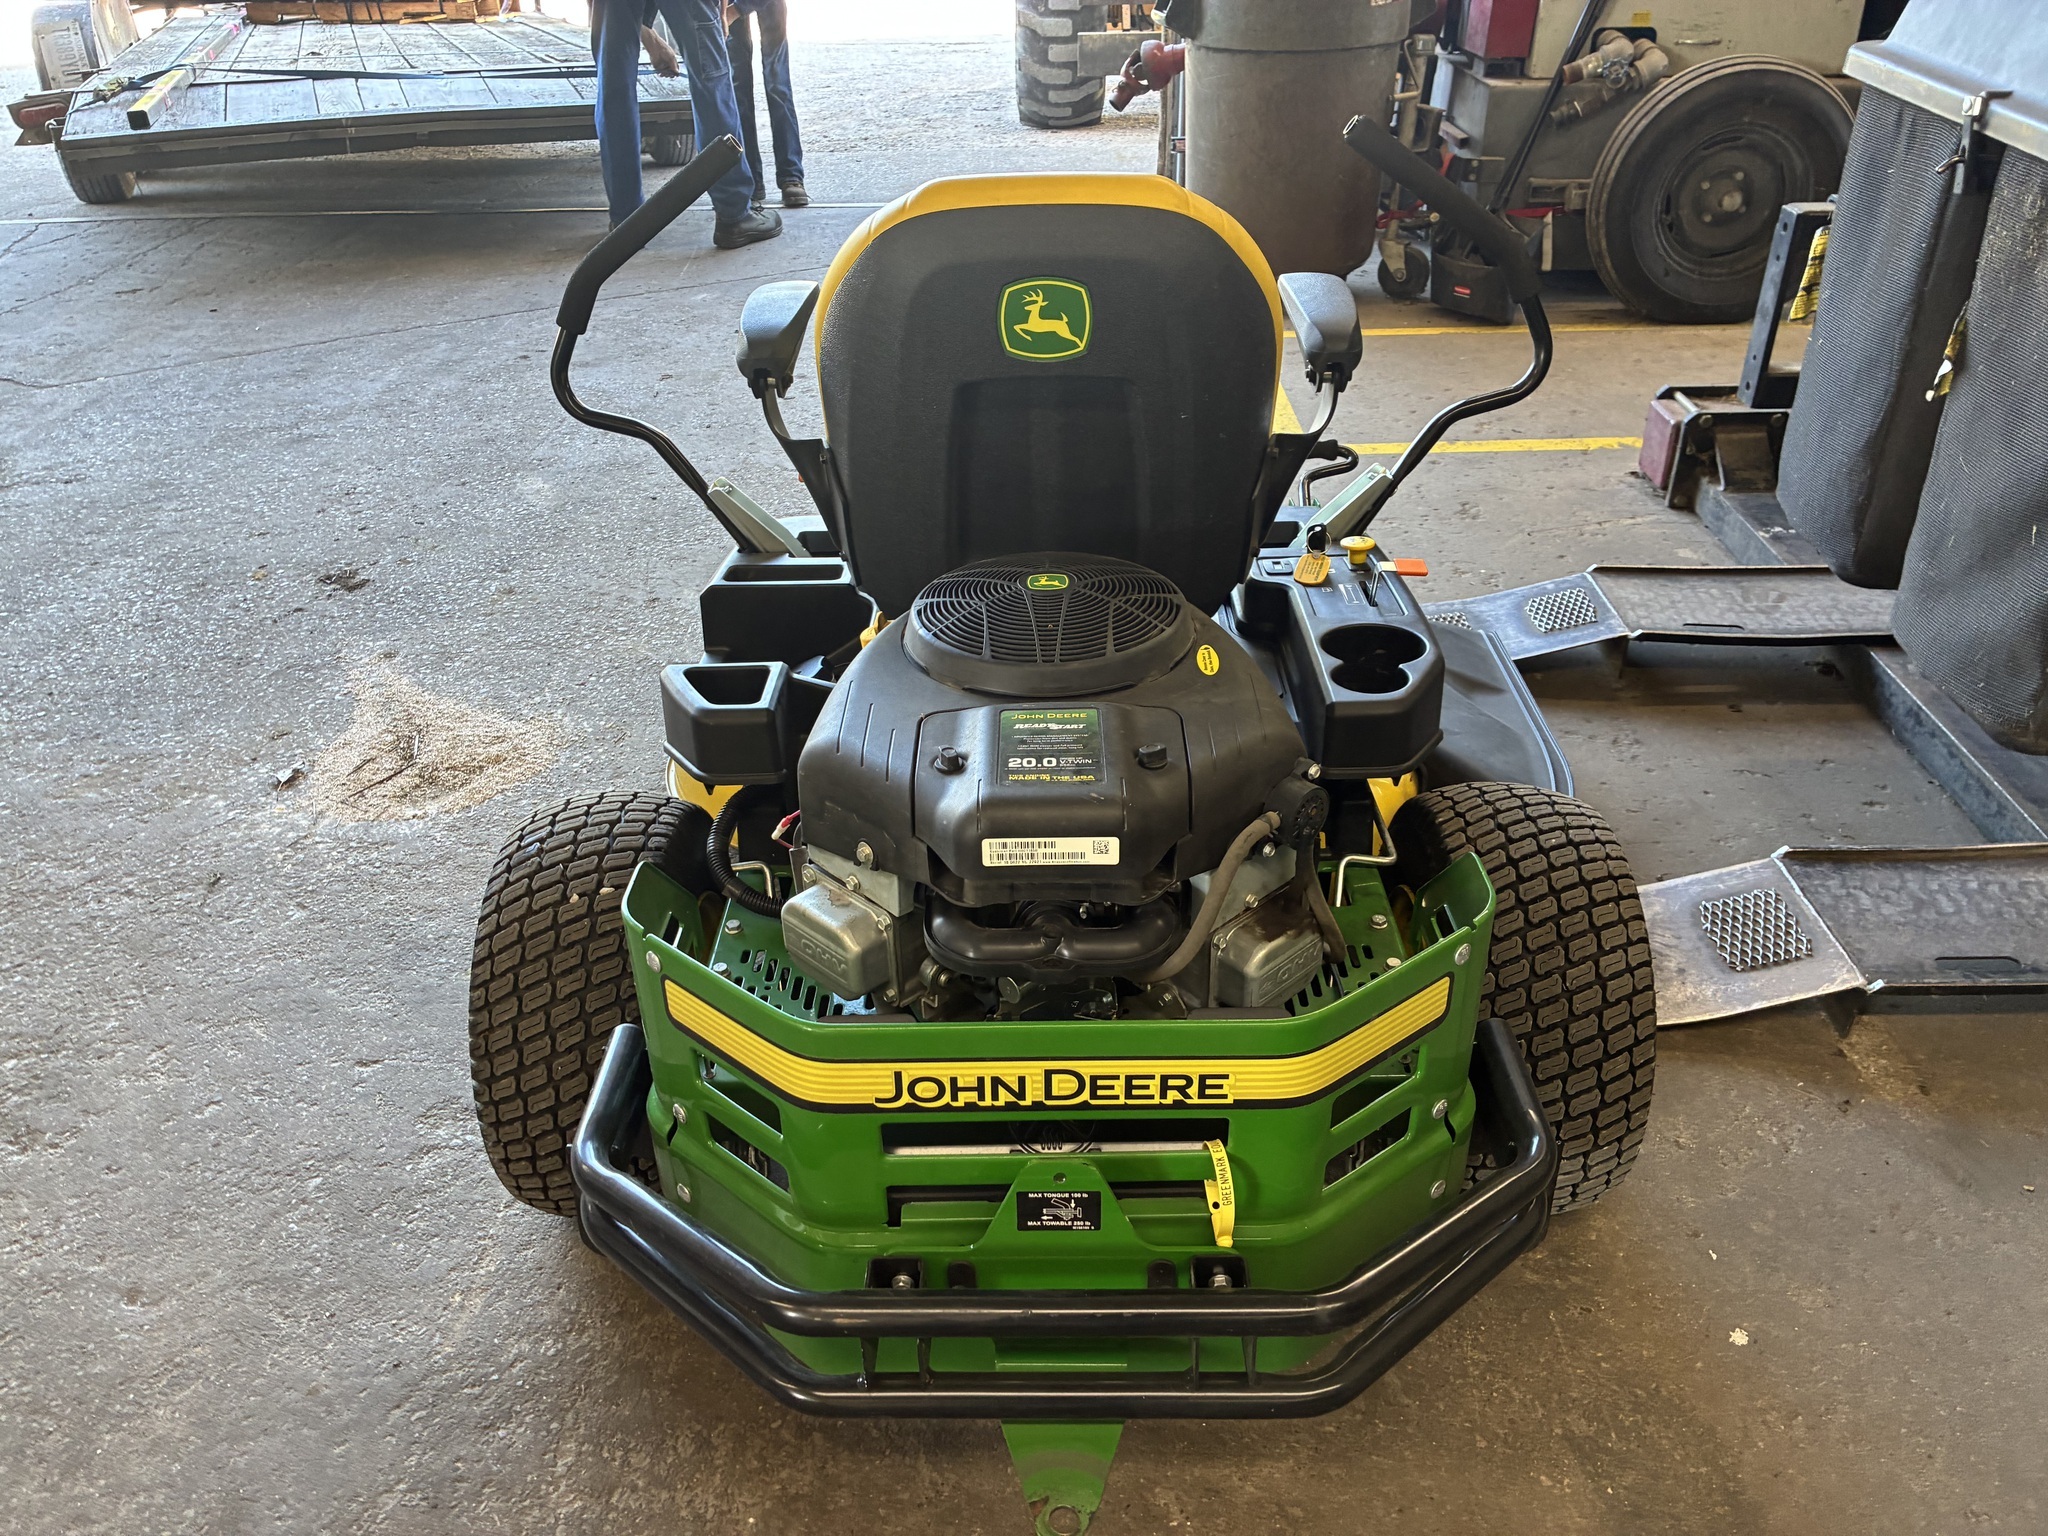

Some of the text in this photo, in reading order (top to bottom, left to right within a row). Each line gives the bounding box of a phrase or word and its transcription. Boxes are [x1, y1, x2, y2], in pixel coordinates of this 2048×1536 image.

[1008, 757, 1057, 768] 20.0
[874, 1069, 1231, 1105] JOHN DEERE
[1216, 1156, 1233, 1207] GREENMARK
